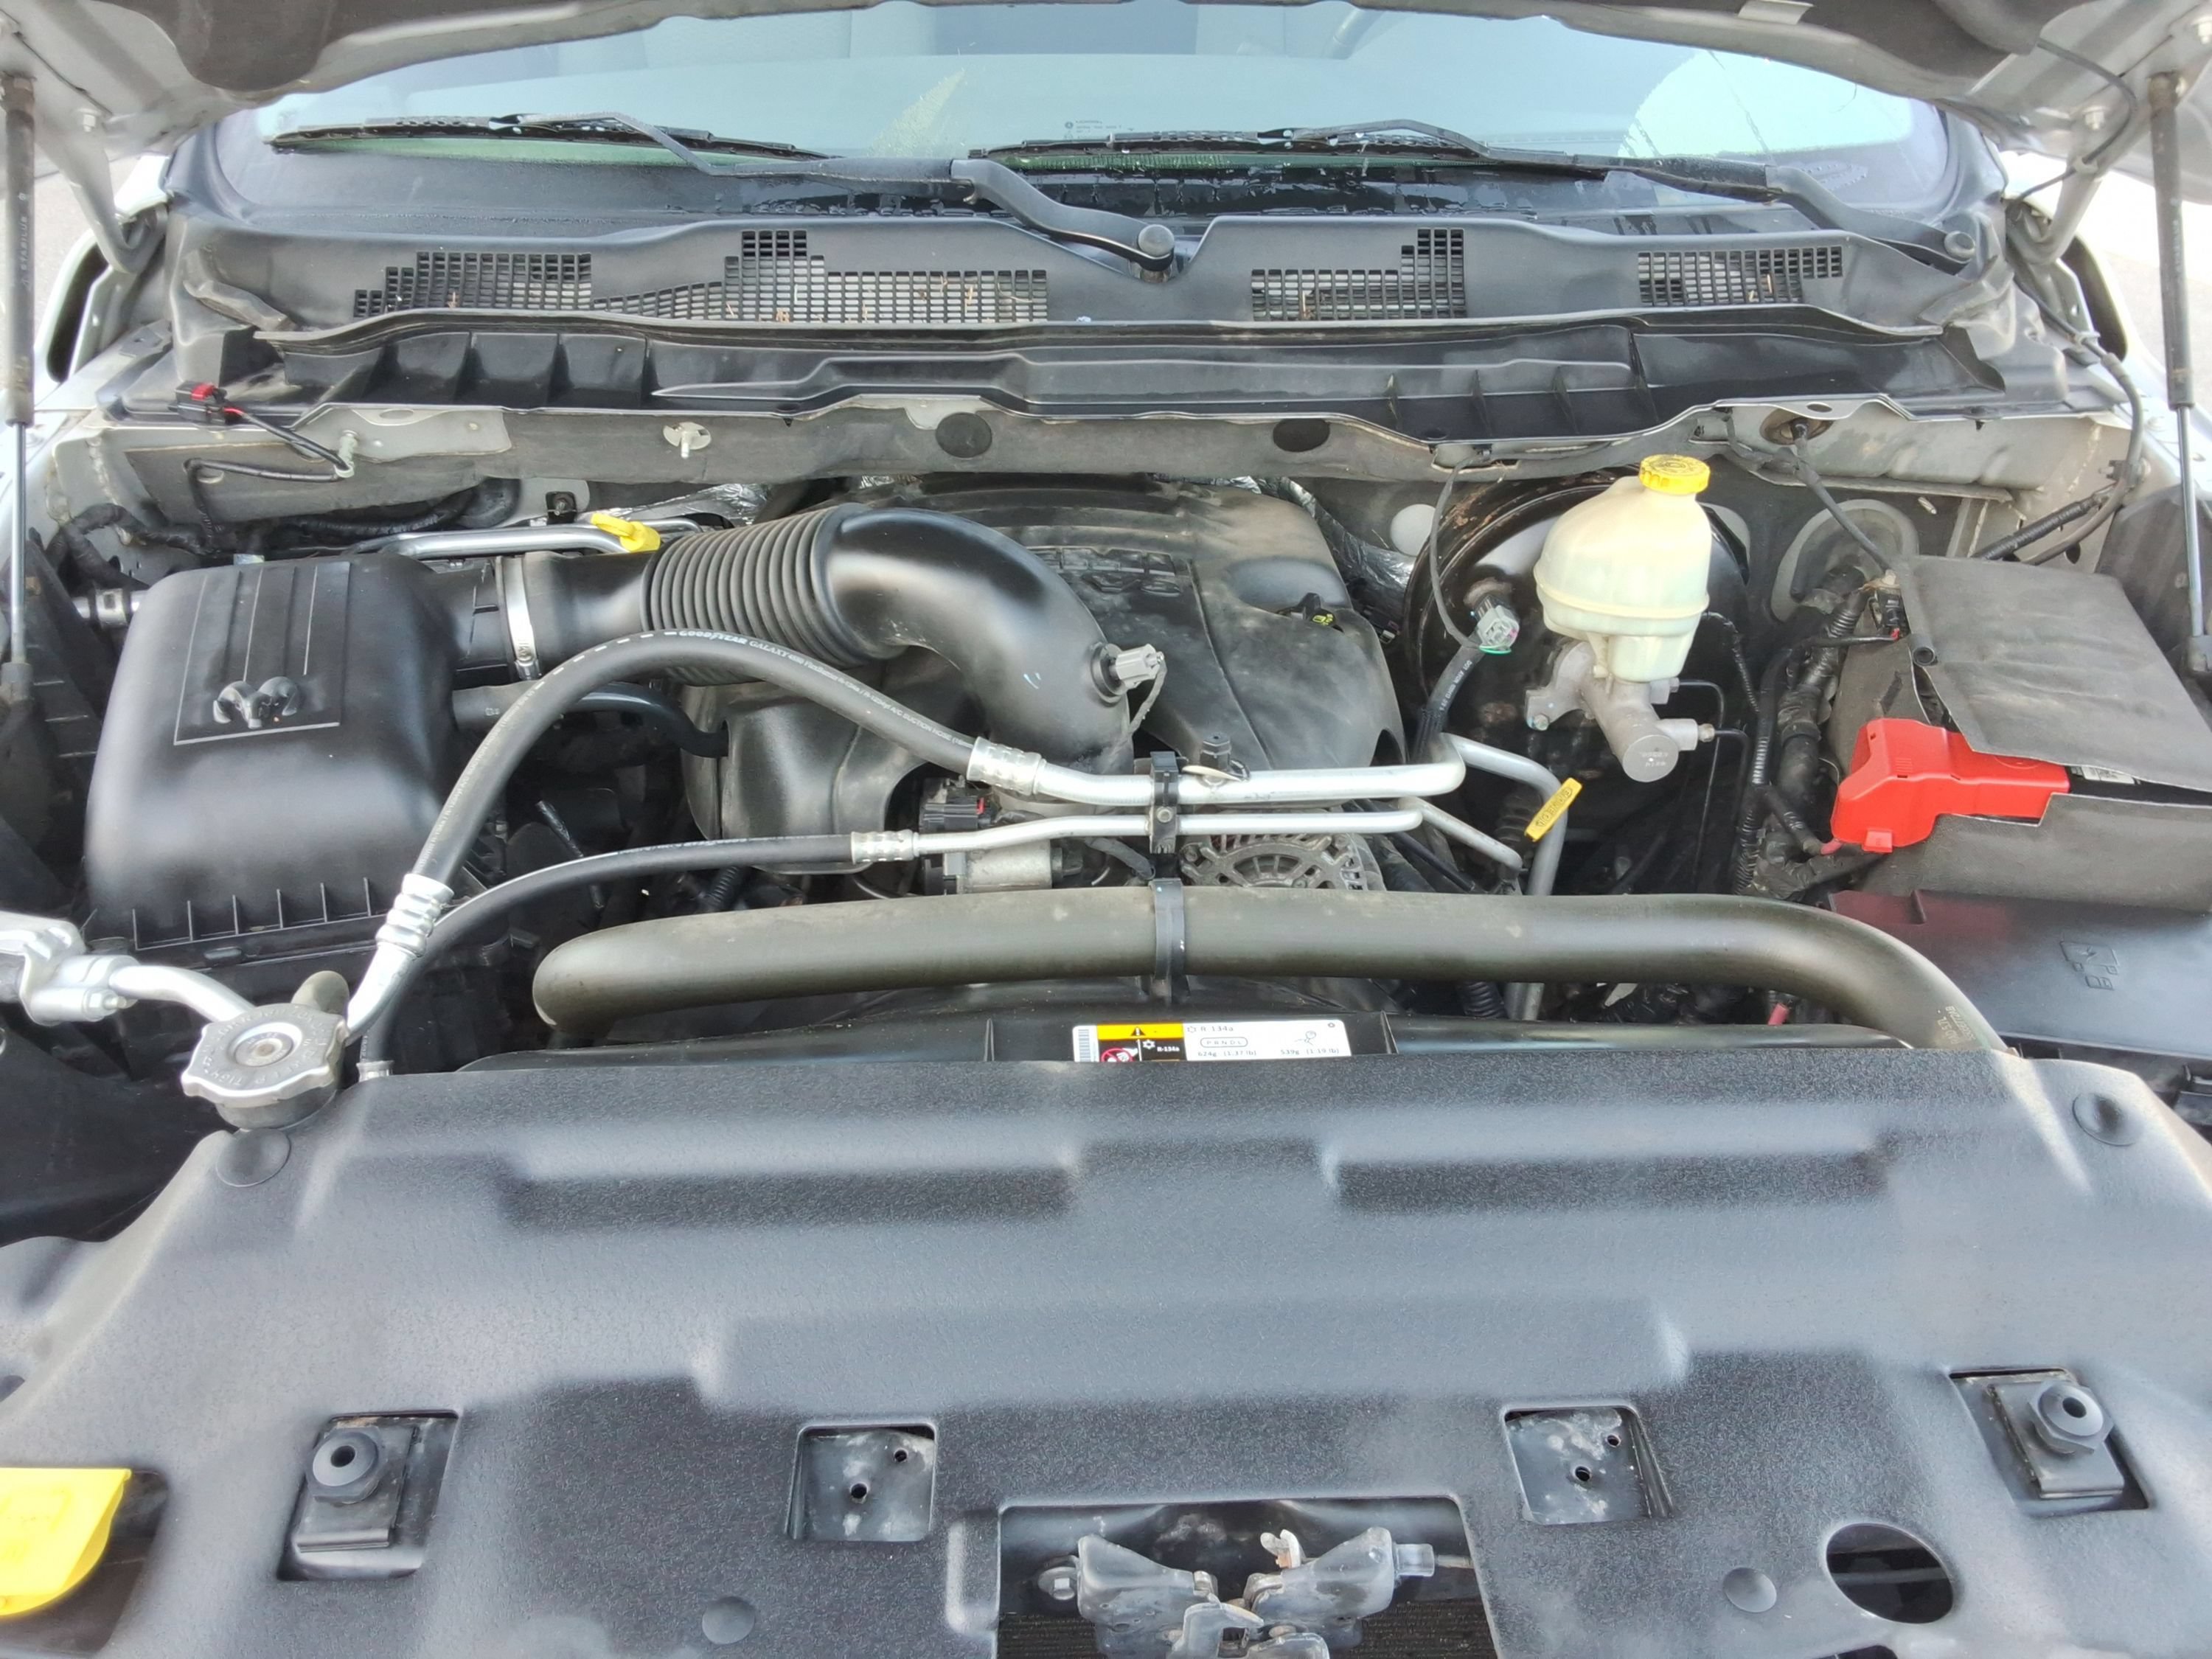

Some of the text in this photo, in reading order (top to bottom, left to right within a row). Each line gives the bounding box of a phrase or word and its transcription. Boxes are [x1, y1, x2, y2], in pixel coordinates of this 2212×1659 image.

[678, 630, 748, 646] GOODYEAR
[749, 640, 790, 658] GALAXY
[890, 705, 903, 717] A/C
[902, 712, 932, 732] SUCTION
[932, 726, 953, 742] HOSE
